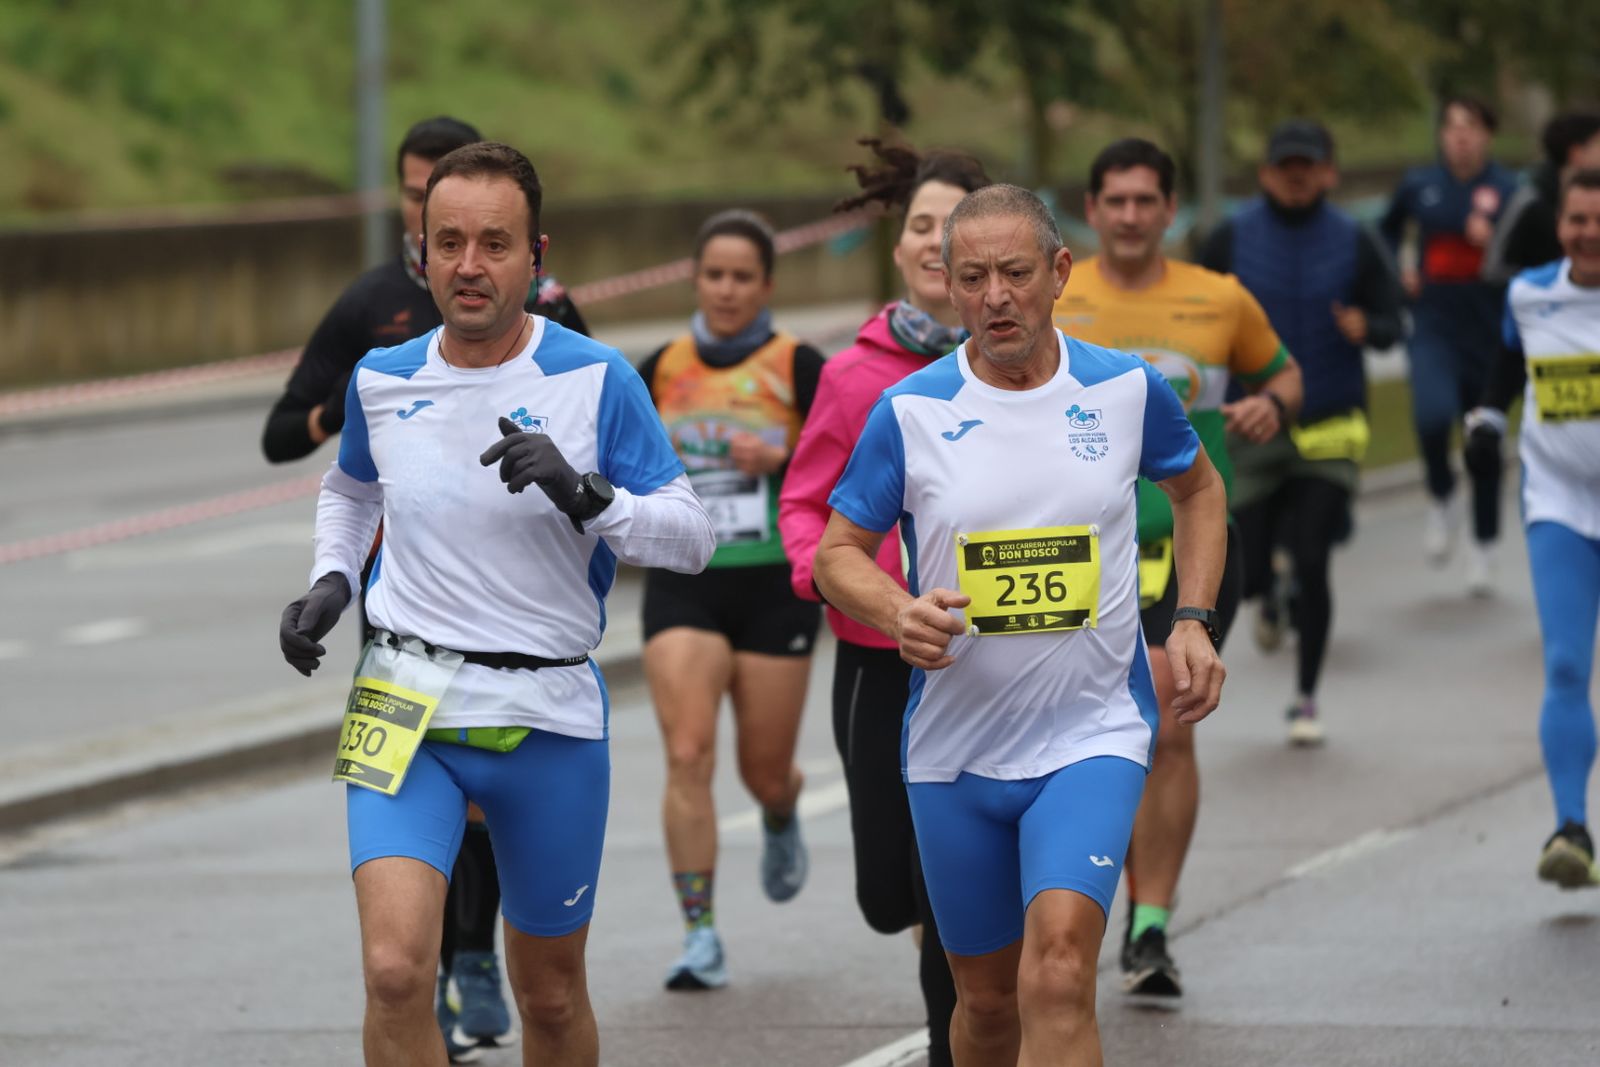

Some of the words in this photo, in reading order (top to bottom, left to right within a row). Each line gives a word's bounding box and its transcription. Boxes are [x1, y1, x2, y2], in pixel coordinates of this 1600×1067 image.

[1070, 444, 1109, 462] RUNNING
[999, 543, 1015, 551] XXXI
[1015, 541, 1047, 550] CARRERA
[1047, 539, 1077, 548] POPULAR
[999, 550, 1021, 560] DON
[1023, 547, 1059, 558] BOSCO
[995, 571, 1067, 607] 236
[369, 699, 396, 714] BOSCO
[342, 720, 388, 757] 330
